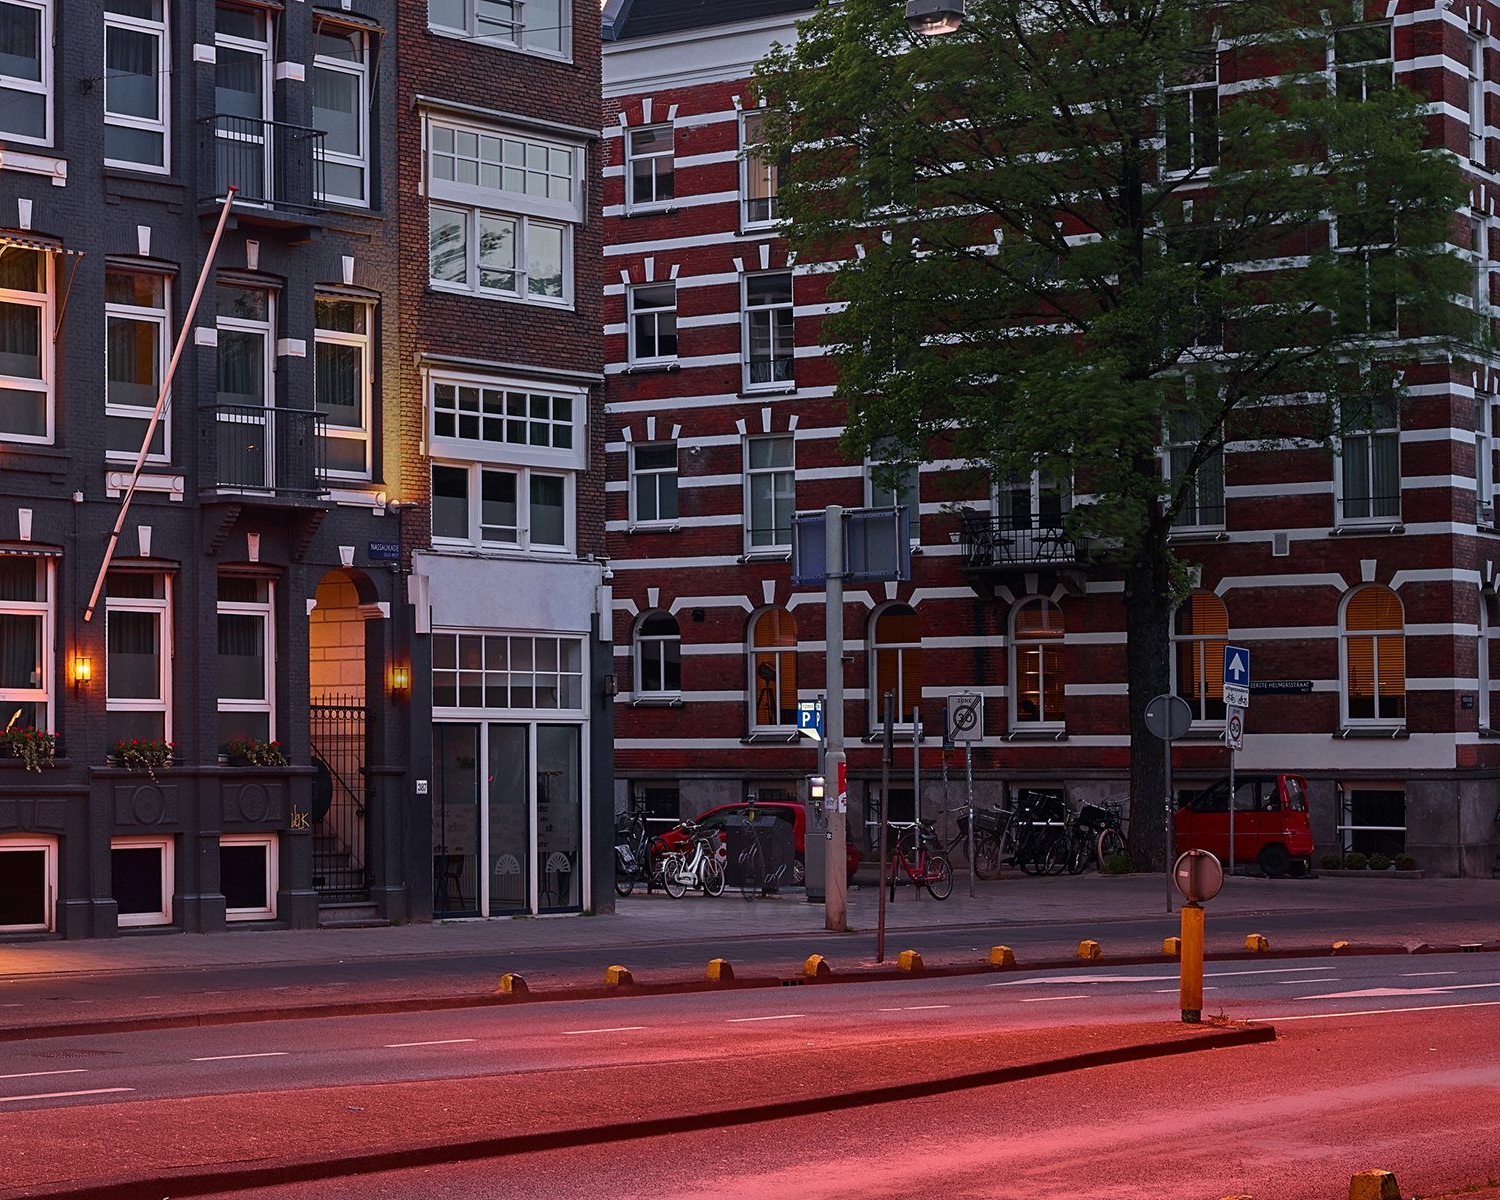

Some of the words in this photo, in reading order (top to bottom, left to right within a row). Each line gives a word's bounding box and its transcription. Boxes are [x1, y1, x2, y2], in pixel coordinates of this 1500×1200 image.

[802, 711, 811, 728] P
[957, 713, 973, 724] 30
[1232, 722, 1239, 732] 30
